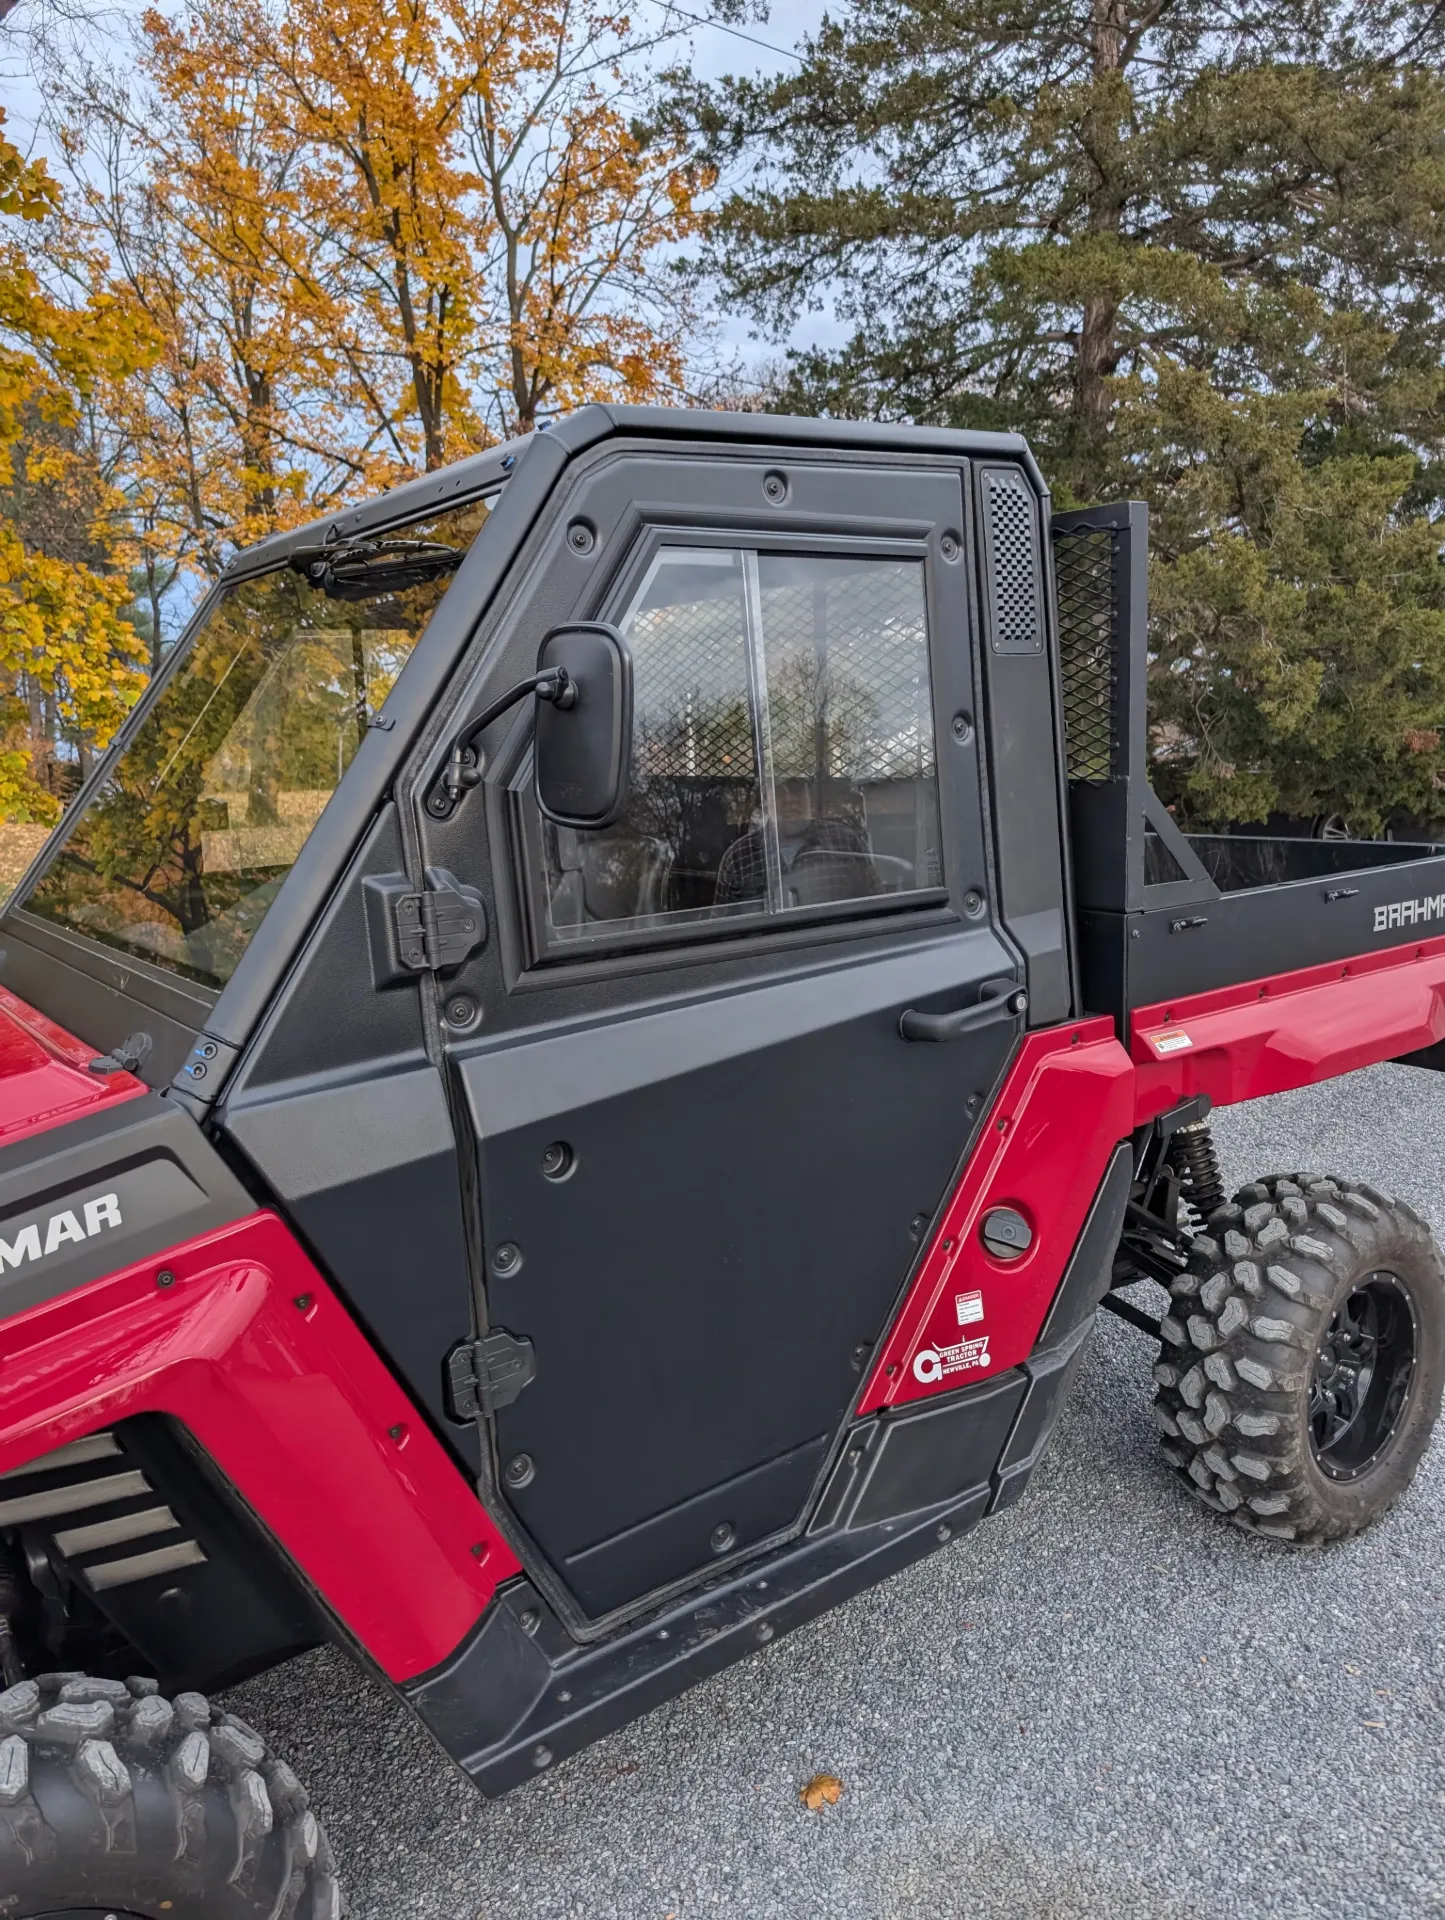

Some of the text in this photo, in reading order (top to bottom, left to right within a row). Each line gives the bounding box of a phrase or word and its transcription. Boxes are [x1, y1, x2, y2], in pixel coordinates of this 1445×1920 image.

[939, 1342, 983, 1358] GREEN SPRING
[946, 1350, 977, 1362] TRACTOR
[943, 1362, 972, 1374] NEWVILLE,
